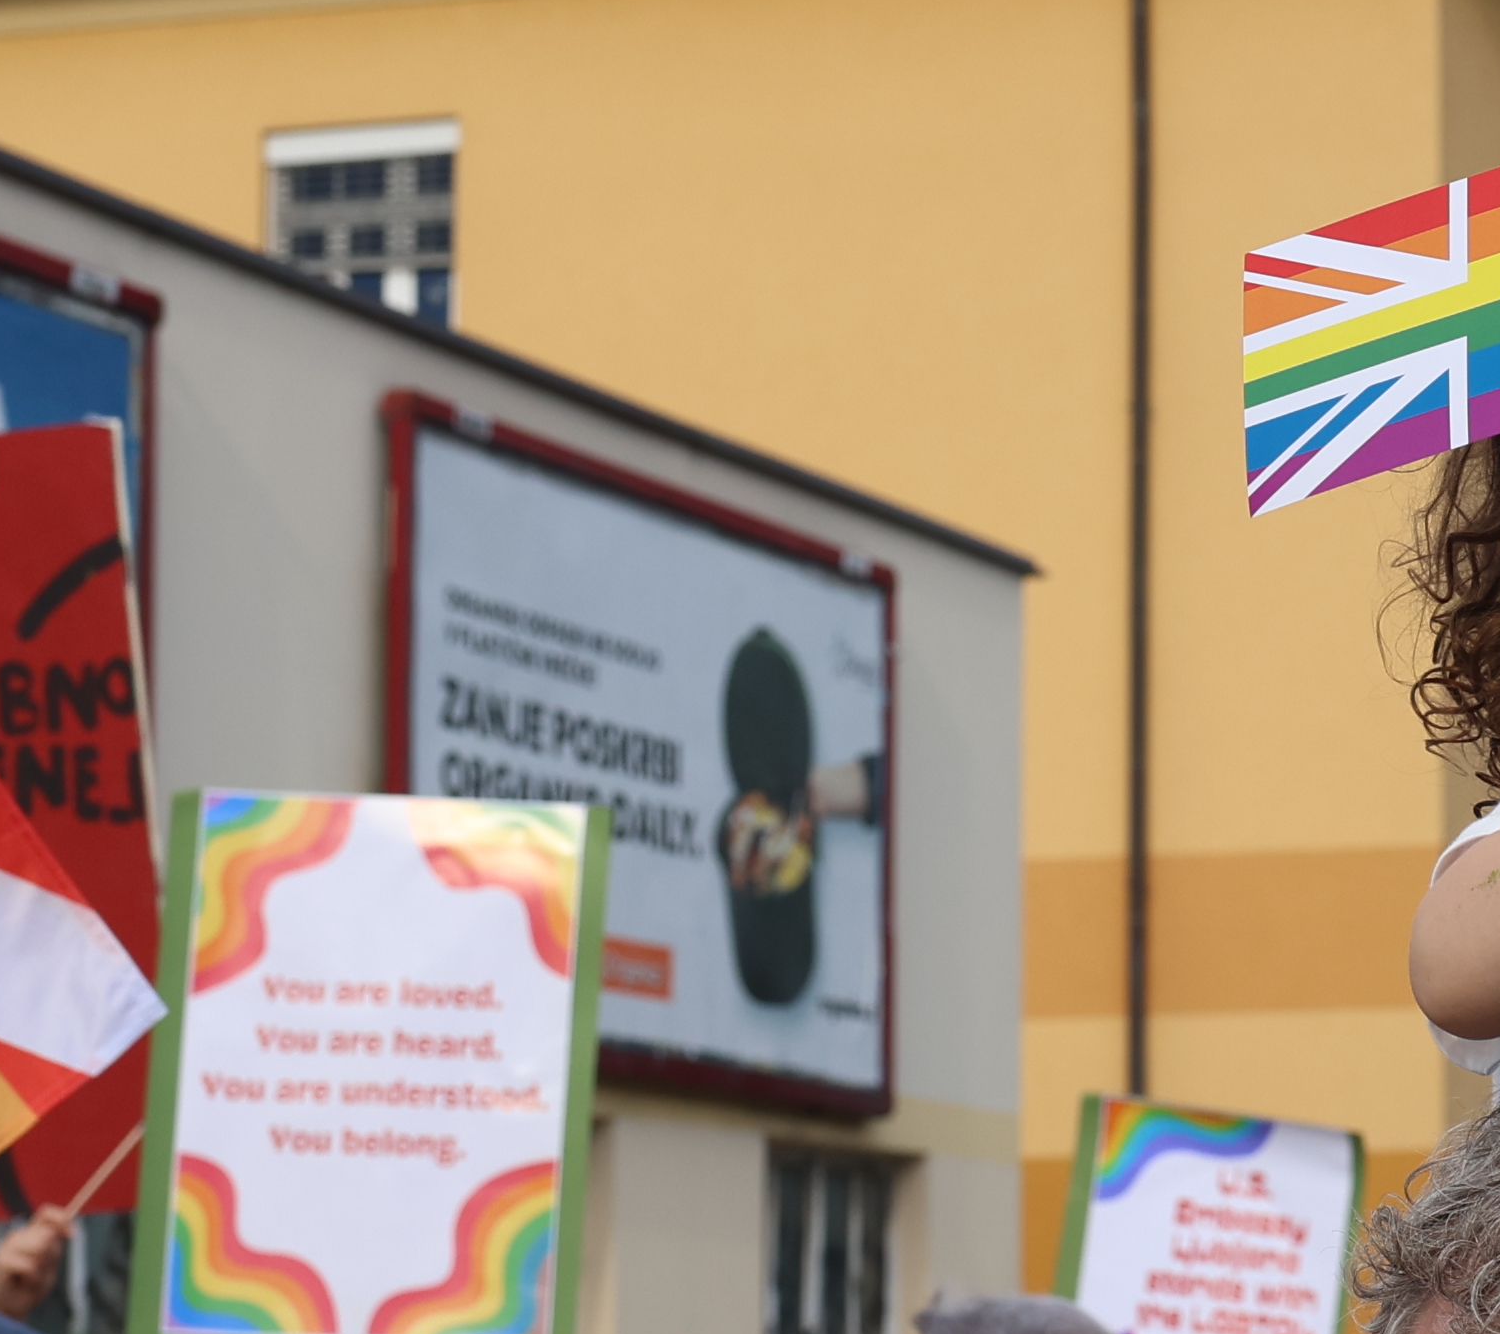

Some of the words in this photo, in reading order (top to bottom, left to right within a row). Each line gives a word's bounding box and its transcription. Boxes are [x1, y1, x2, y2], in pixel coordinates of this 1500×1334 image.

[263, 975, 325, 1003] You
[335, 980, 390, 1006] are
[400, 978, 503, 1011] loved.
[256, 1025, 320, 1054] You
[329, 1030, 383, 1055] are
[393, 1026, 503, 1062] heard.
[201, 1073, 266, 1103] You
[276, 1079, 331, 1105] are
[341, 1079, 549, 1112] understood.
[268, 1126, 332, 1154] You
[343, 1127, 466, 1166] belong.
